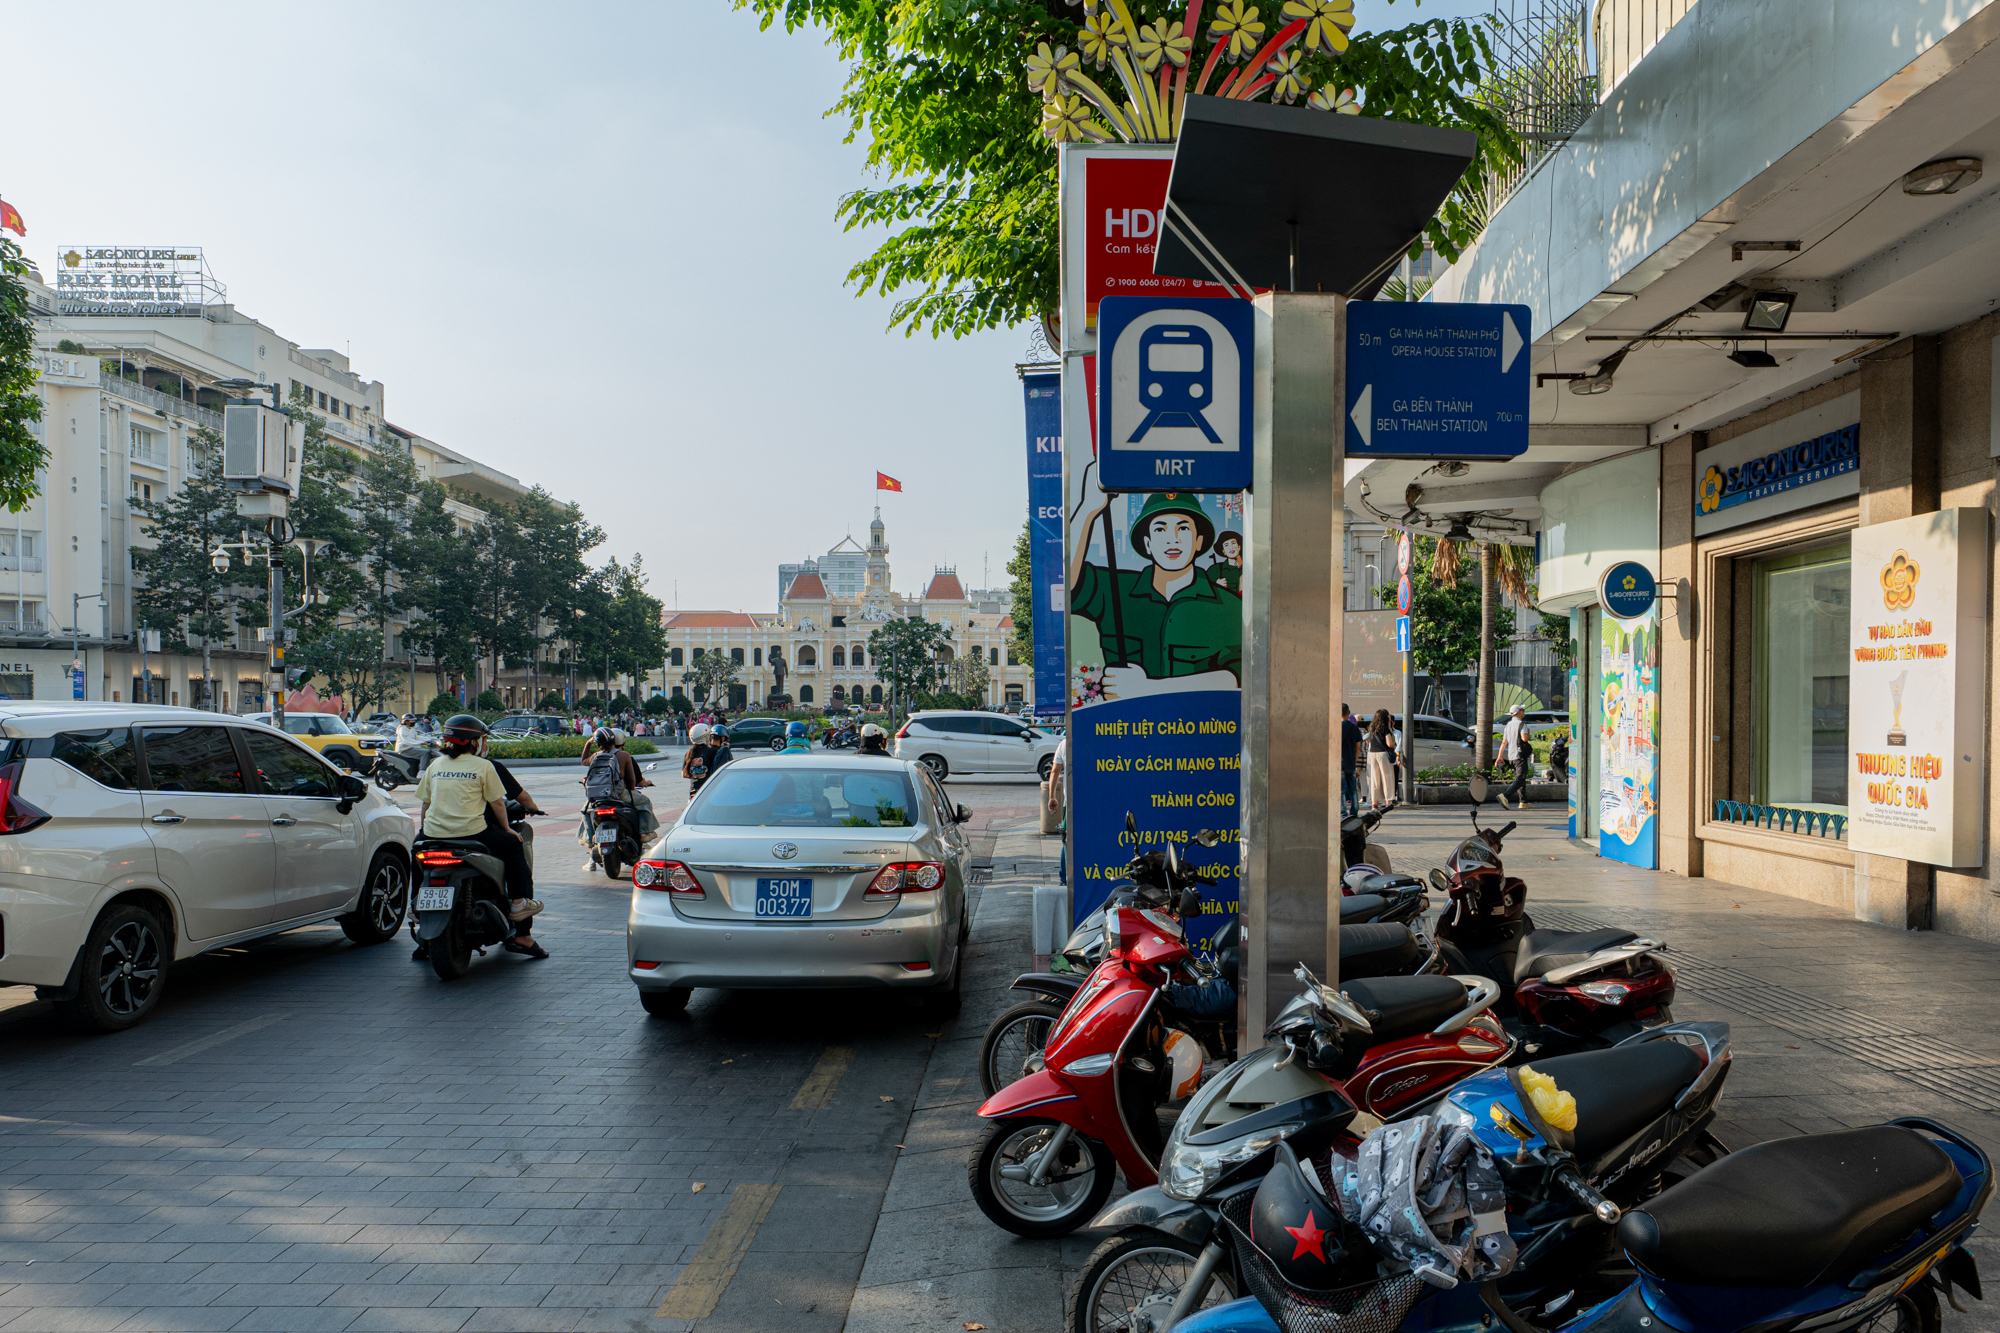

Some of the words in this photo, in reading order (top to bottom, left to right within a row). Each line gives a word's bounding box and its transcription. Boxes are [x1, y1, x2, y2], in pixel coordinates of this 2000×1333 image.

[86, 249, 175, 260] SAIGONTOURIST
[1105, 242, 1131, 254] Cam
[1136, 242, 1155, 254] kết
[58, 274, 106, 288] REX
[111, 274, 183, 288] HOTEL
[1118, 278, 1137, 287] 1900
[1139, 278, 1160, 287] 6060
[1161, 277, 1186, 288] (24/7)
[58, 290, 109, 300] ROOFTOP
[110, 291, 155, 301] GARDEN
[158, 292, 181, 301] BAR
[1359, 333, 1371, 346] 50
[1373, 336, 1382, 346] m
[1389, 327, 1402, 339] GA
[1404, 325, 1424, 339] NHÀ
[1426, 325, 1443, 340] HÁT
[1447, 327, 1478, 340] THÀNH
[1391, 345, 1422, 357] OPERA
[1425, 346, 1455, 357] HOUSE
[1457, 347, 1497, 358] STATION
[1393, 400, 1408, 412] GA
[1411, 396, 1432, 412] BẾN
[1435, 398, 1473, 413] THÀNH
[1496, 411, 1512, 422] 700
[1514, 413, 1523, 422] m
[1377, 418, 1398, 431] BEN
[1401, 419, 1439, 432] THANH
[1441, 419, 1488, 432] STATION
[1726, 423, 1859, 492] SAIGONTOURIST
[1155, 459, 1195, 476] MRT
[1749, 480, 1790, 499] TRAVEL
[1799, 460, 1854, 484] SERVICE
[1609, 590, 1650, 598] SAIGONTOURIST
[1868, 625, 1879, 642] TỰ
[1879, 621, 1895, 639] HÀO
[1897, 618, 1914, 638] DẪN
[1914, 617, 1933, 637] ĐẦU
[1854, 646, 1876, 662] VỮNG
[1876, 643, 1898, 661] BƯỚC
[1899, 643, 1916, 660] TIÊN
[1917, 643, 1948, 659] PHONG
[0, 663, 34, 673] NEL
[1095, 719, 1129, 739] NHIỆT
[1132, 719, 1154, 739] LIỆT
[1157, 718, 1196, 735] CHÀO
[1199, 717, 1237, 735] MỪNG
[1096, 755, 1131, 772] NGÀY
[1135, 754, 1173, 771] CÁCH
[1176, 756, 1215, 774] MẠNG
[1218, 753, 1241, 770] THÁ
[1856, 752, 1906, 777] THƯƠNG
[1910, 752, 1942, 783] HIỆU
[1151, 790, 1193, 807] THÀNH
[1196, 790, 1235, 807] CÔNG
[1867, 777, 1902, 806] QUỐC
[1905, 785, 1929, 810] GIA
[1118, 830, 1188, 847] (19/8/1945
[1084, 863, 1101, 880] VÀ
[423, 889, 449, 899] 59-U2
[770, 880, 799, 897] 50M
[420, 899, 449, 909] 581.54
[757, 898, 811, 915] 003.77
[1196, 899, 1224, 915] HĨA
[1227, 900, 1239, 914] VI
